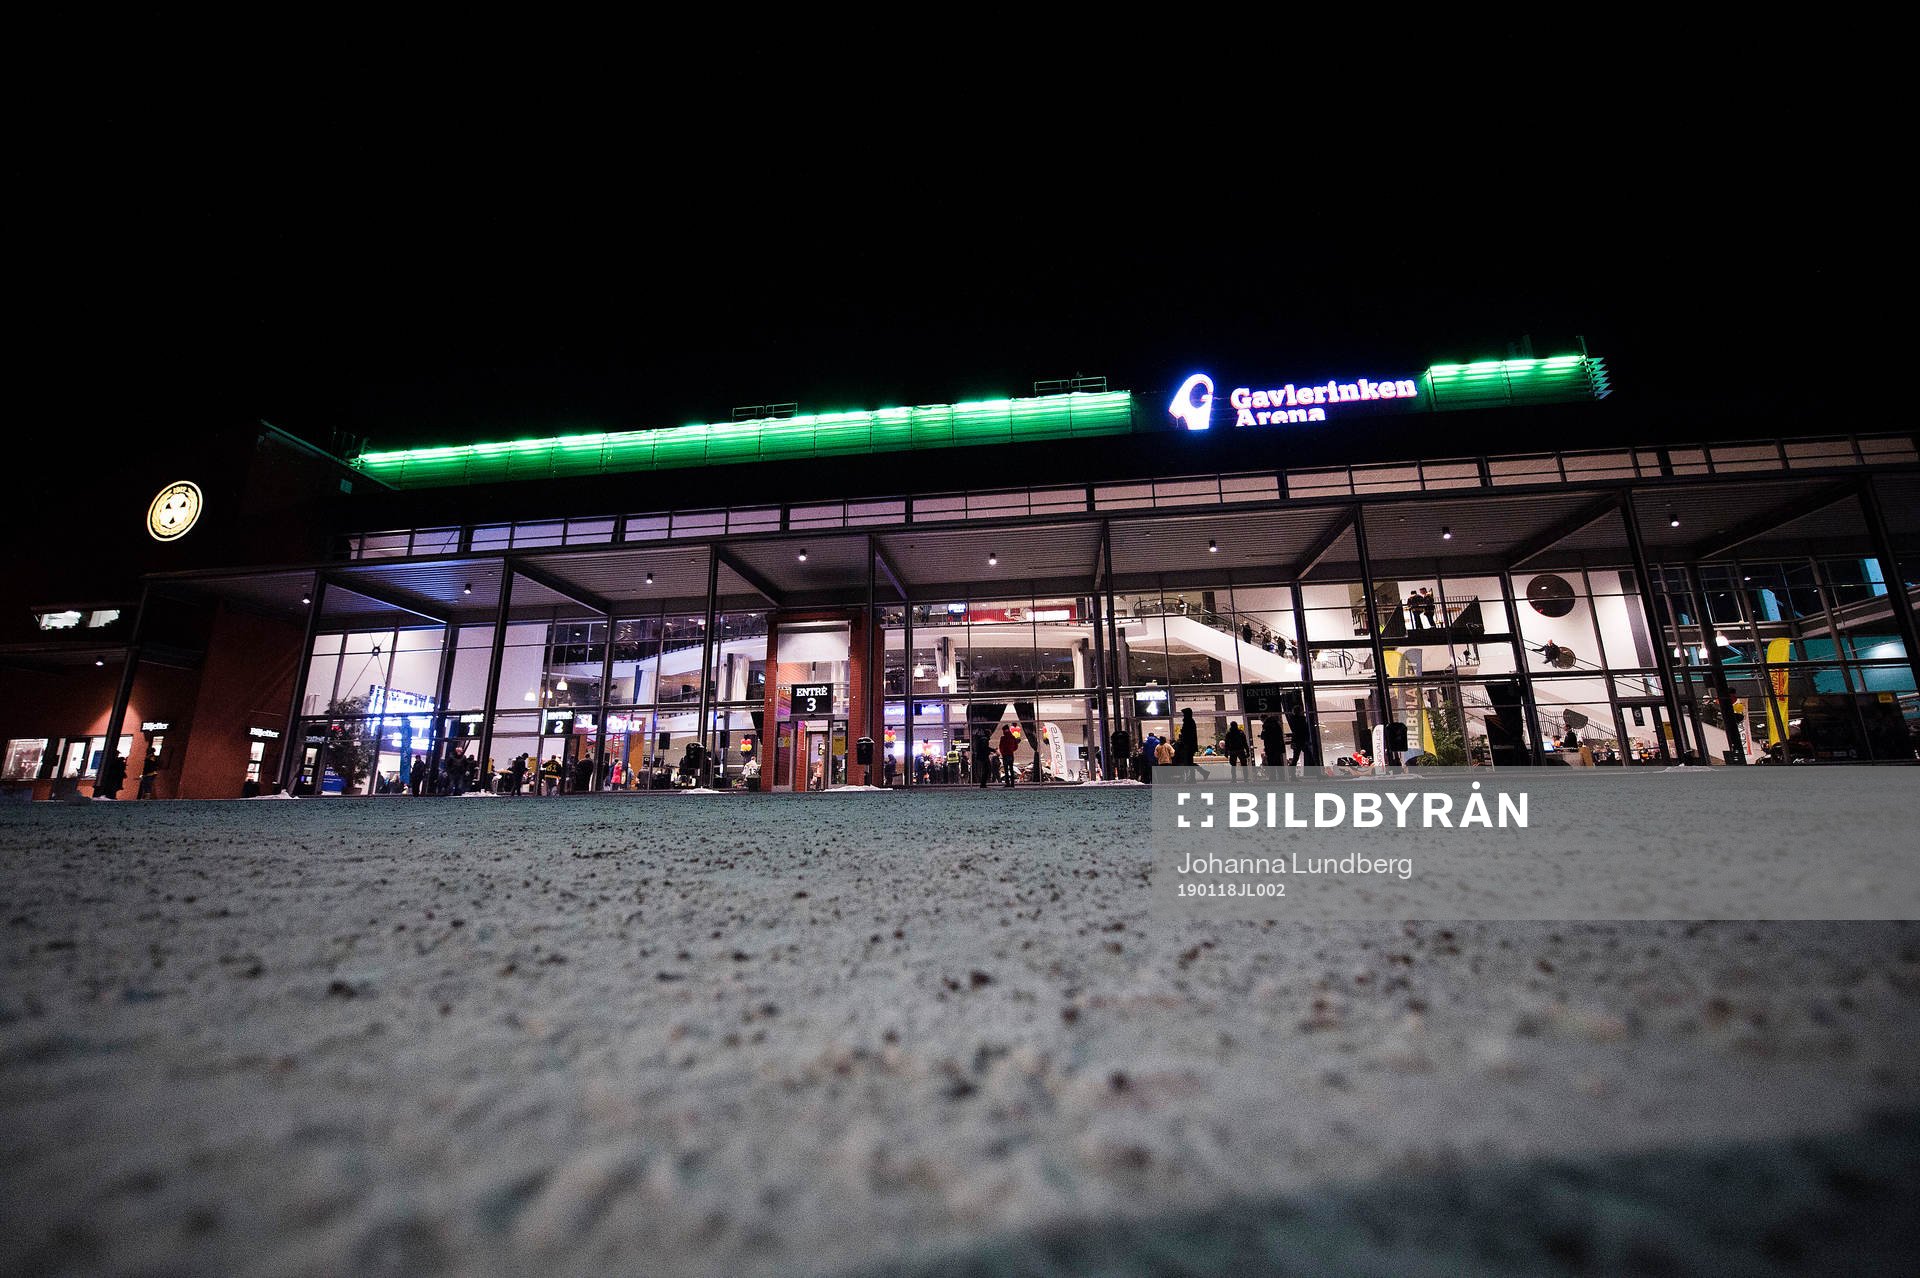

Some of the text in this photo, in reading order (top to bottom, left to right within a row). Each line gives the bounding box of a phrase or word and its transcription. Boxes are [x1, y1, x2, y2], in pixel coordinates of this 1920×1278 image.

[1231, 379, 1417, 410] Gavlerinken
[1236, 407, 1325, 427] Arena
[806, 698, 817, 712] 3
[1147, 701, 1158, 715] 4
[1258, 698, 1268, 711] 5
[1405, 660, 1420, 749] BILBOLAET
[467, 723, 475, 735] 1
[554, 721, 564, 733] 2
